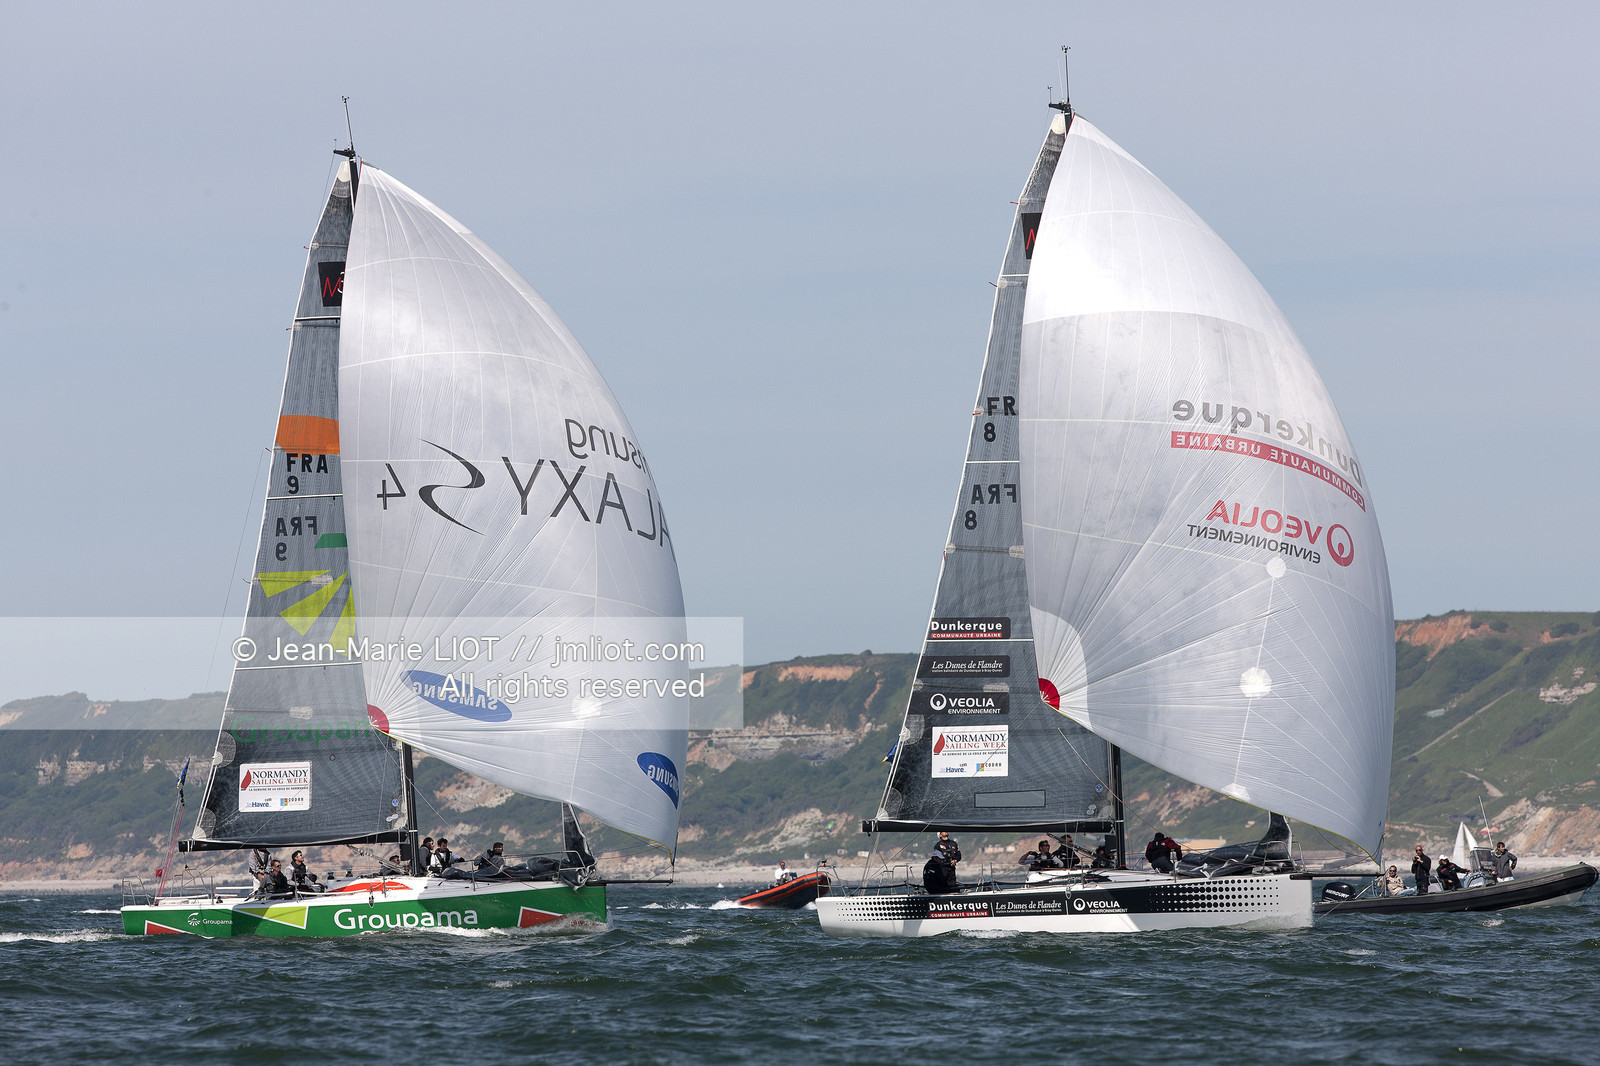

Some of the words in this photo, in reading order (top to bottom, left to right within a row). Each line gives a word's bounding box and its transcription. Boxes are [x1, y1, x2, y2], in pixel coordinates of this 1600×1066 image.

[987, 396, 1016, 416] FR
[984, 422, 996, 442] 8
[286, 453, 328, 474] FRA
[286, 475, 299, 494] 9
[931, 621, 1003, 632] Dunkerque
[932, 661, 944, 669] Les
[945, 660, 967, 669] Dunes
[968, 660, 976, 669] de
[977, 660, 1003, 669] Flandre
[949, 697, 995, 707] VEOLIA
[231, 716, 379, 747] Groupam
[946, 733, 1006, 743] NORMANDY
[252, 769, 309, 779] NORMANDY
[929, 901, 988, 911] Dunkerque
[996, 902, 1006, 910] Les
[1007, 901, 1027, 910] Dunes
[1028, 900, 1036, 909] de
[1037, 900, 1062, 909] Flandre
[1086, 900, 1120, 909] VEOLIA
[334, 908, 478, 930] Groupama
